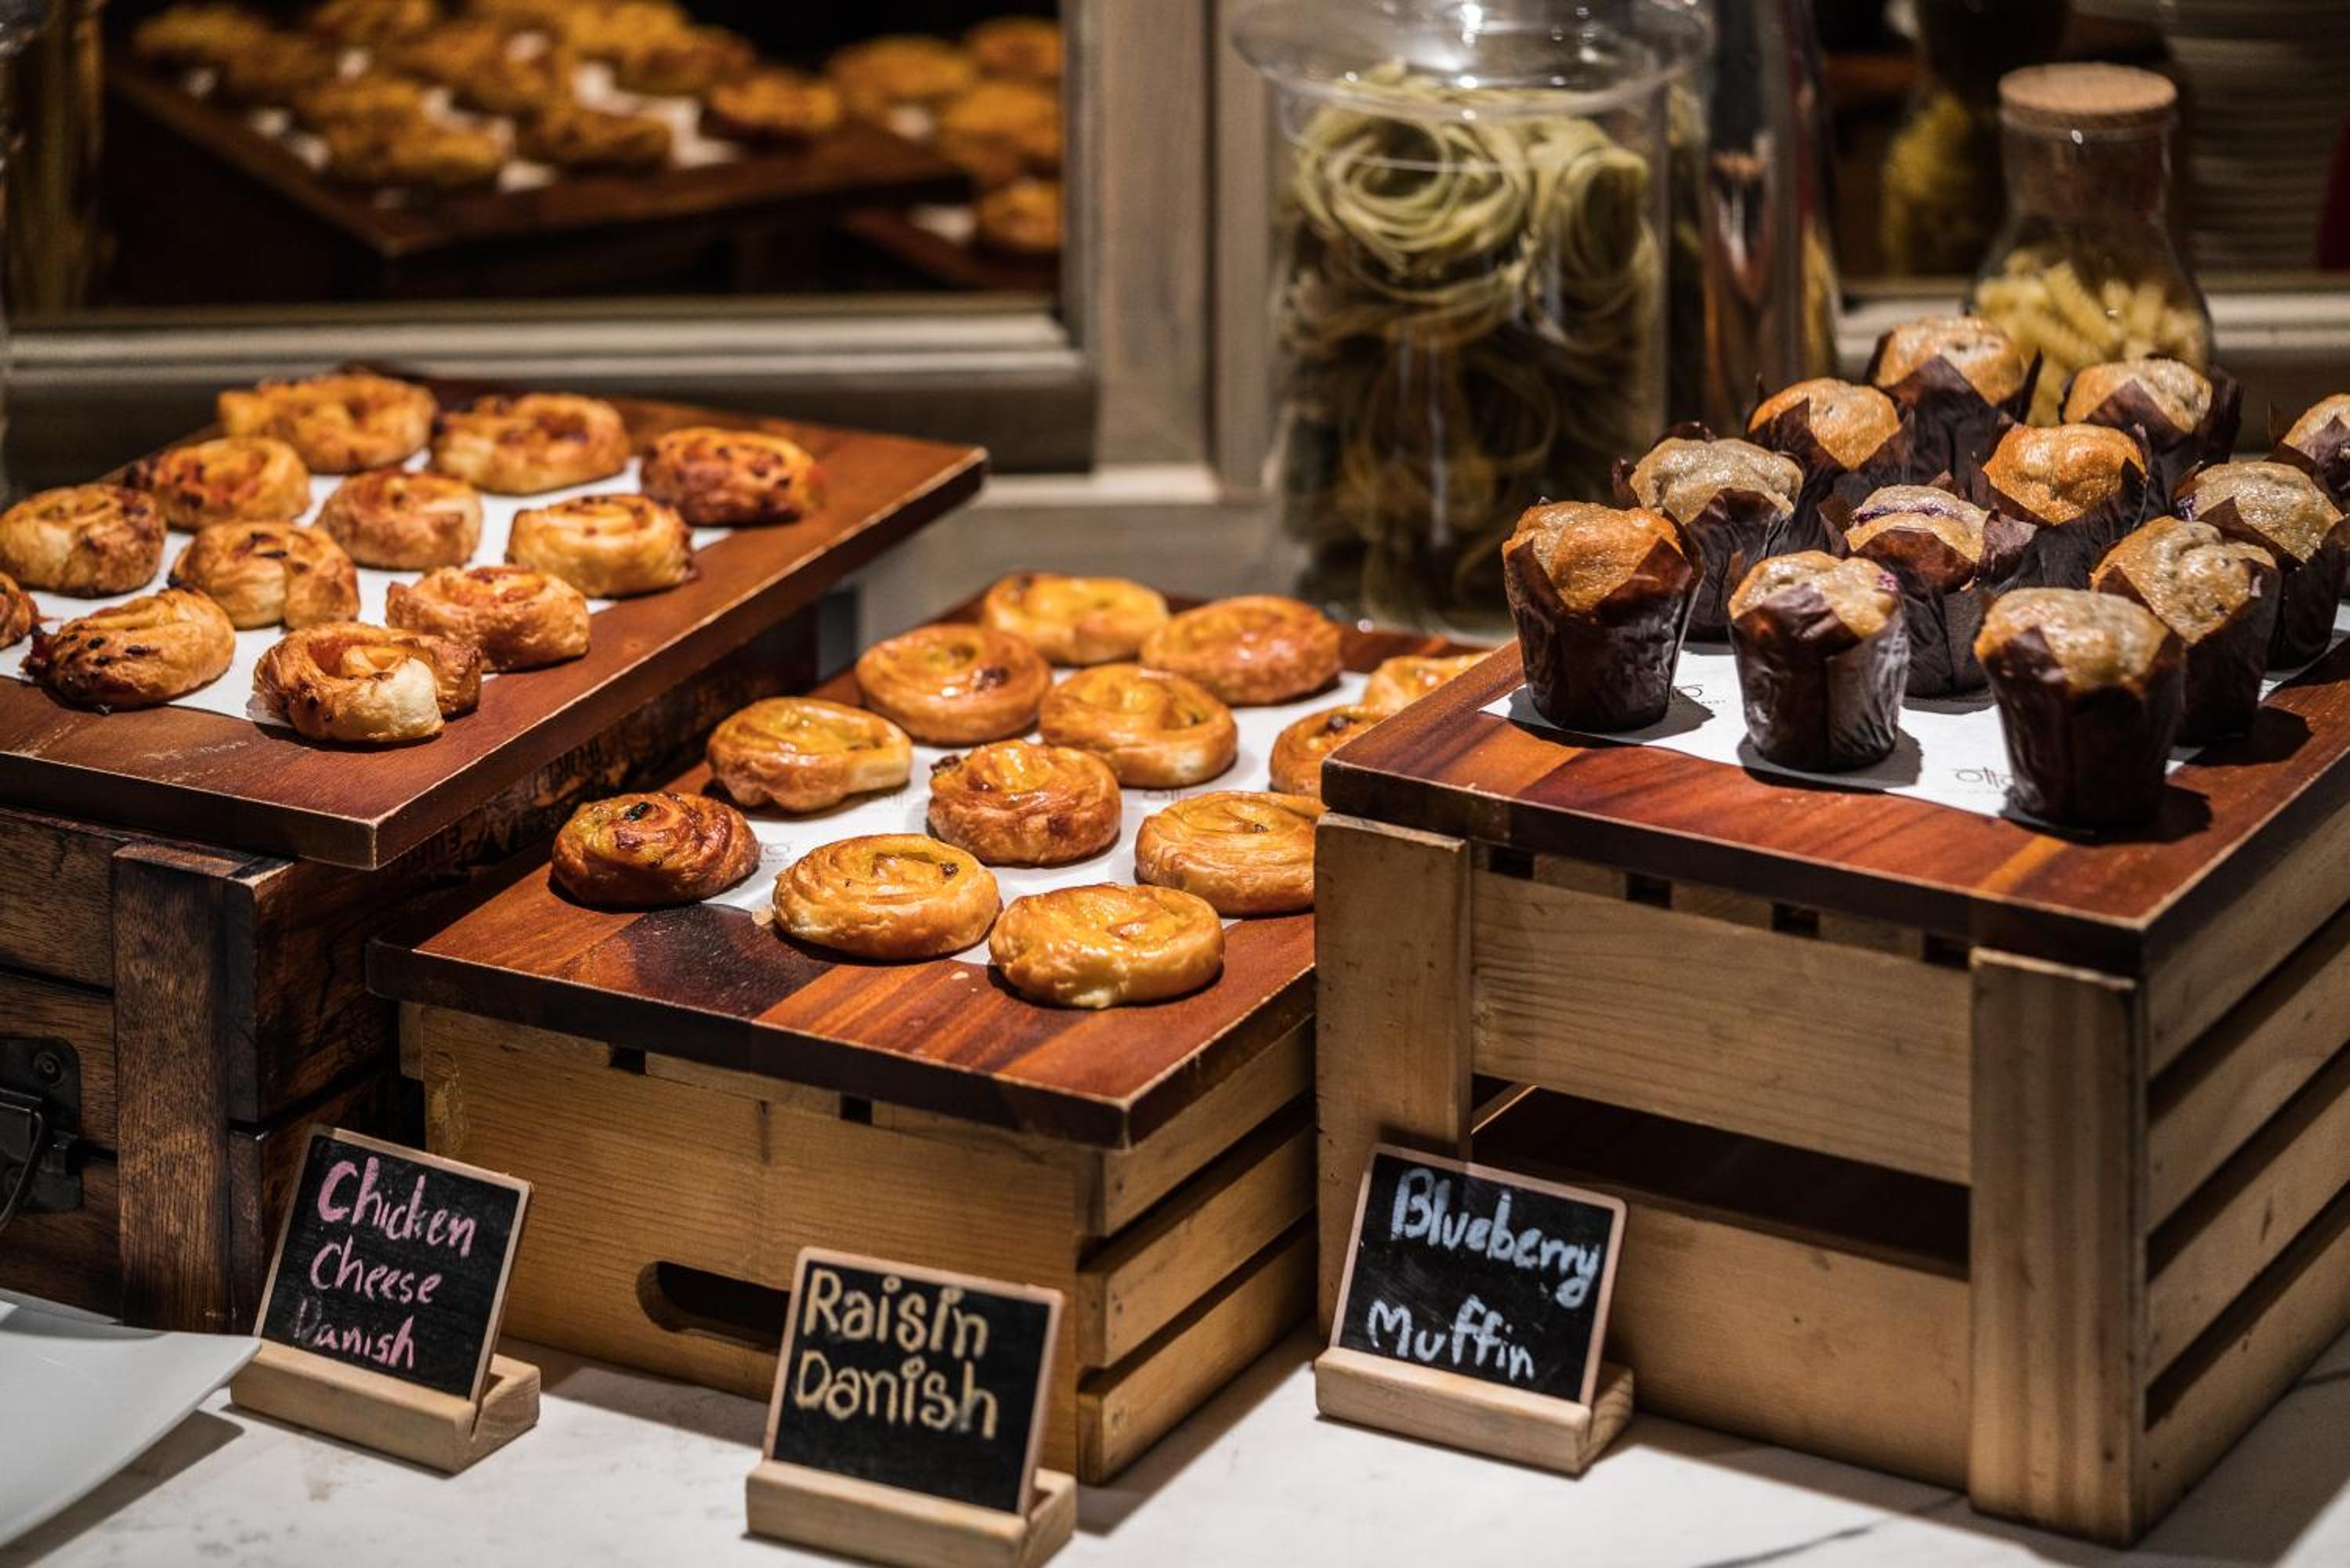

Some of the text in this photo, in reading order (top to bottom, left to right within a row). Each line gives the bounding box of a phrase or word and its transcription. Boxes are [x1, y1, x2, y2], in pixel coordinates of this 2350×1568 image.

[317, 1157, 477, 1257] Chicken
[1390, 1168, 1600, 1309] Blueberry
[310, 1234, 442, 1304] Cheese
[803, 1267, 989, 1360] Raisin
[293, 1298, 414, 1369] Danish
[1366, 1295, 1535, 1381] Muffin
[794, 1349, 998, 1440] Danish
